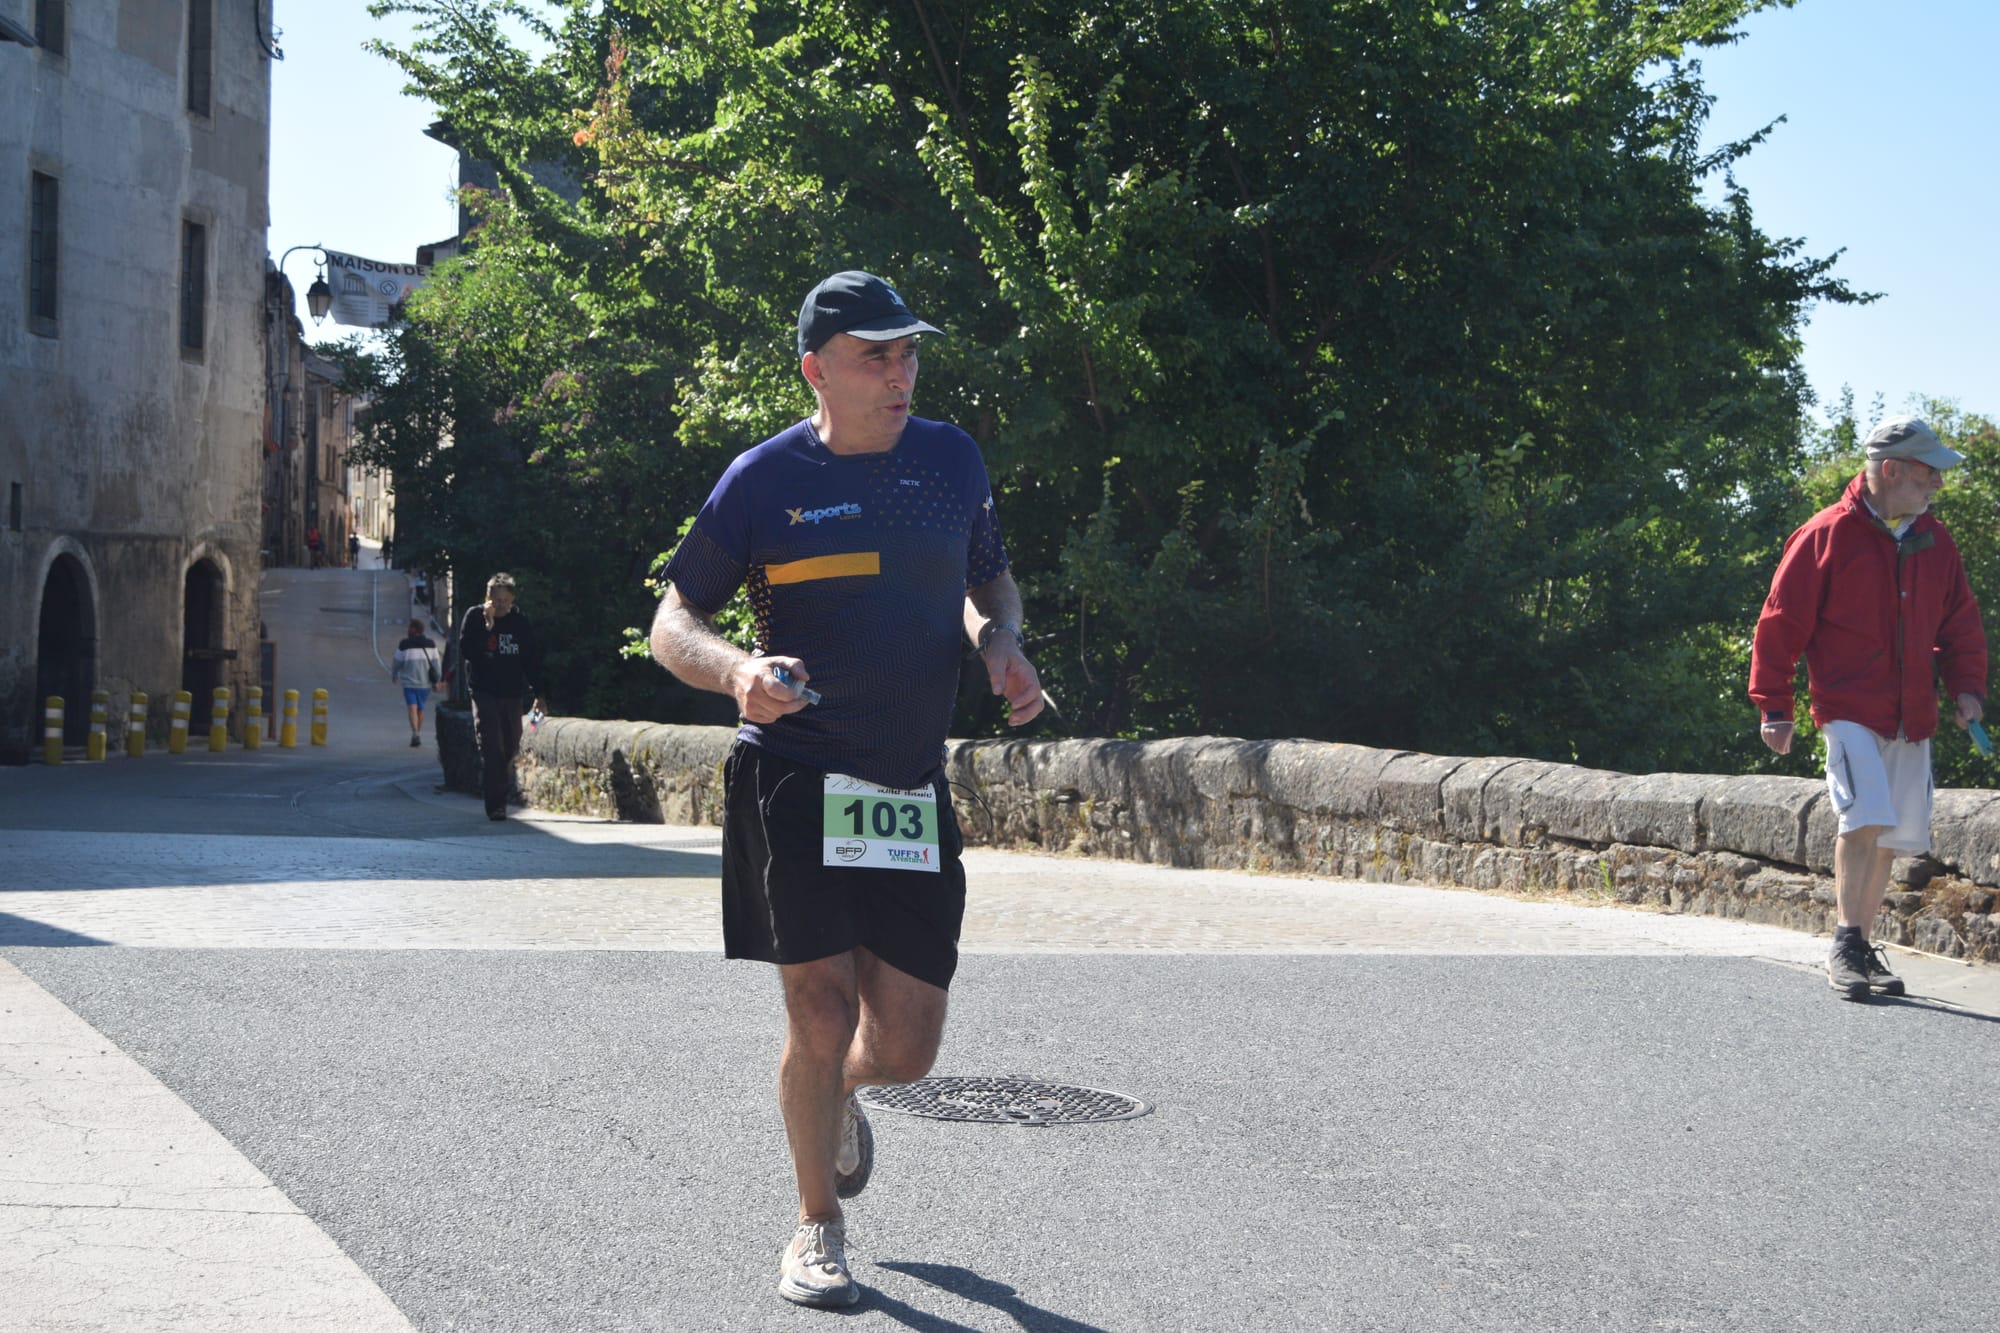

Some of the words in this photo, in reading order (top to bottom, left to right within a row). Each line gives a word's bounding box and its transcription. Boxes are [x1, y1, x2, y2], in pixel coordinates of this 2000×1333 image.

[331, 255, 399, 275] MAISON
[900, 479, 920, 487] TACTIC
[844, 799, 924, 840] 103
[835, 846, 863, 855] BFP
[887, 848, 920, 859] TUFF'S
